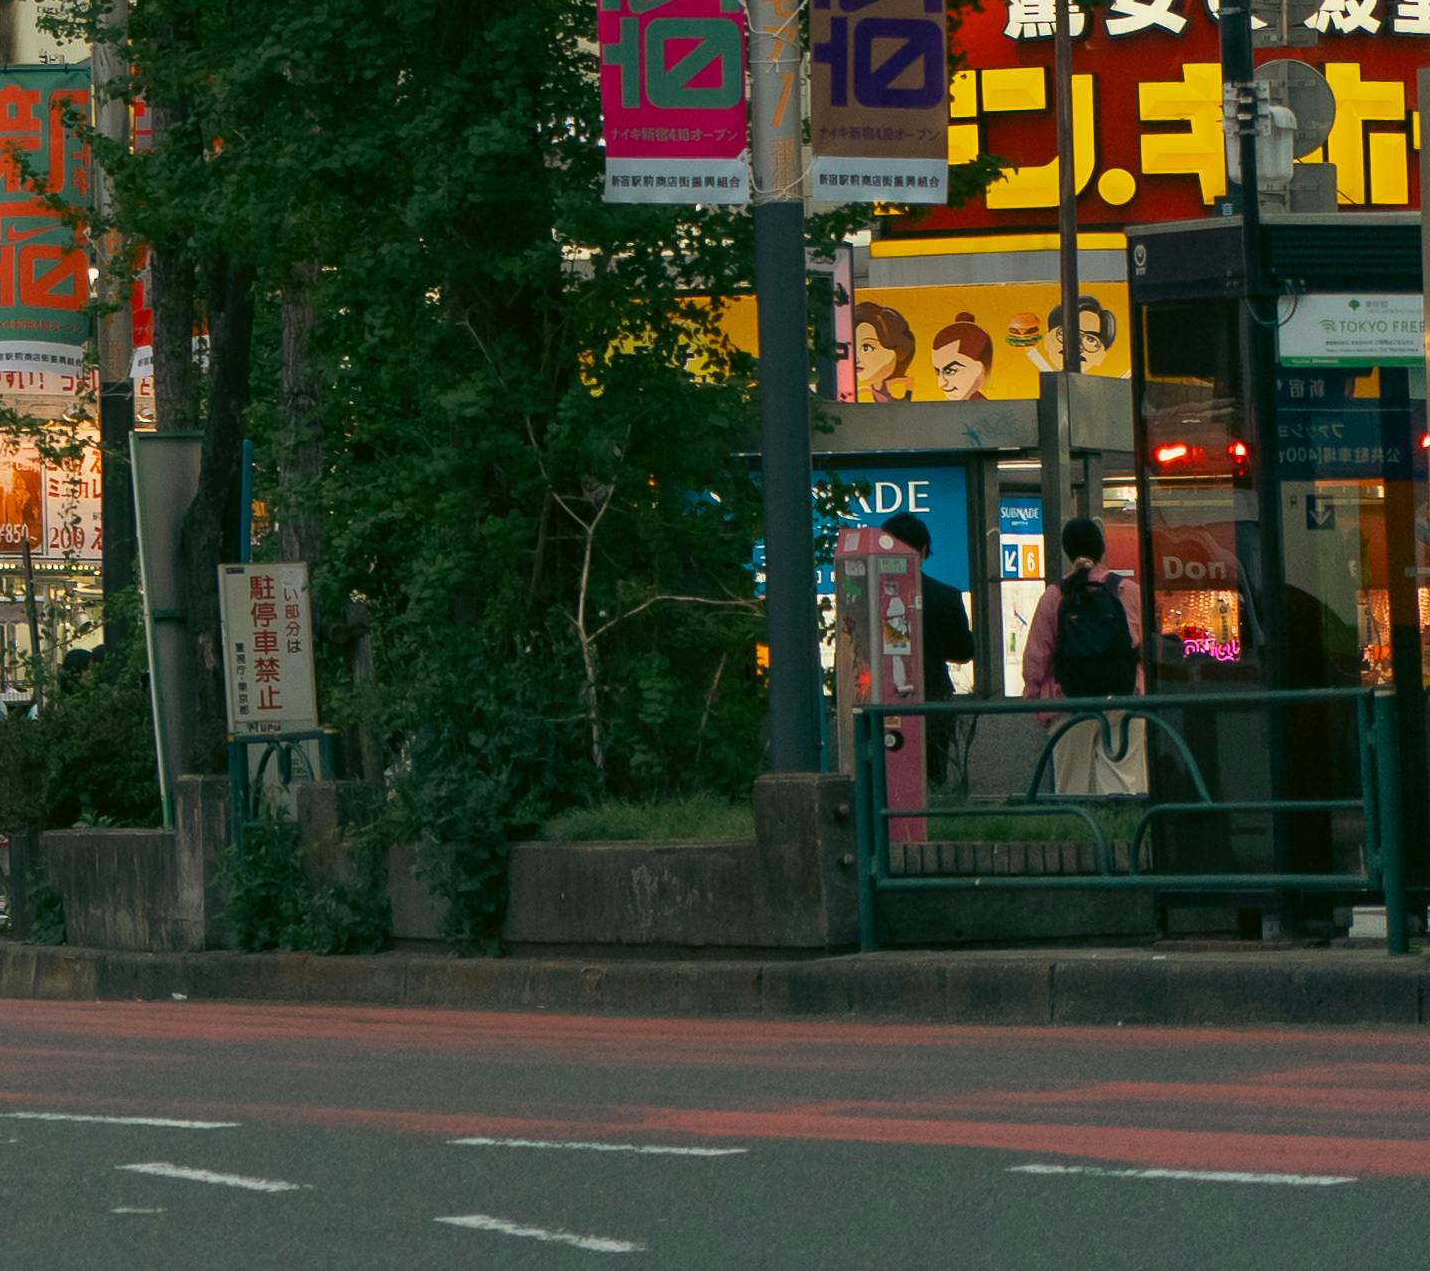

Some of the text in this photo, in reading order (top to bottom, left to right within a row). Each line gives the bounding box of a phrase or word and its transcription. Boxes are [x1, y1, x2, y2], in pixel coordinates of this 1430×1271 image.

[611, 175, 741, 189] 新宿駅前商店街振興組合
[819, 173, 941, 190] 新宿駅前商店街振興組合
[1338, 320, 1388, 333] TOKYO
[249, 575, 283, 710] 駐停車禁止
